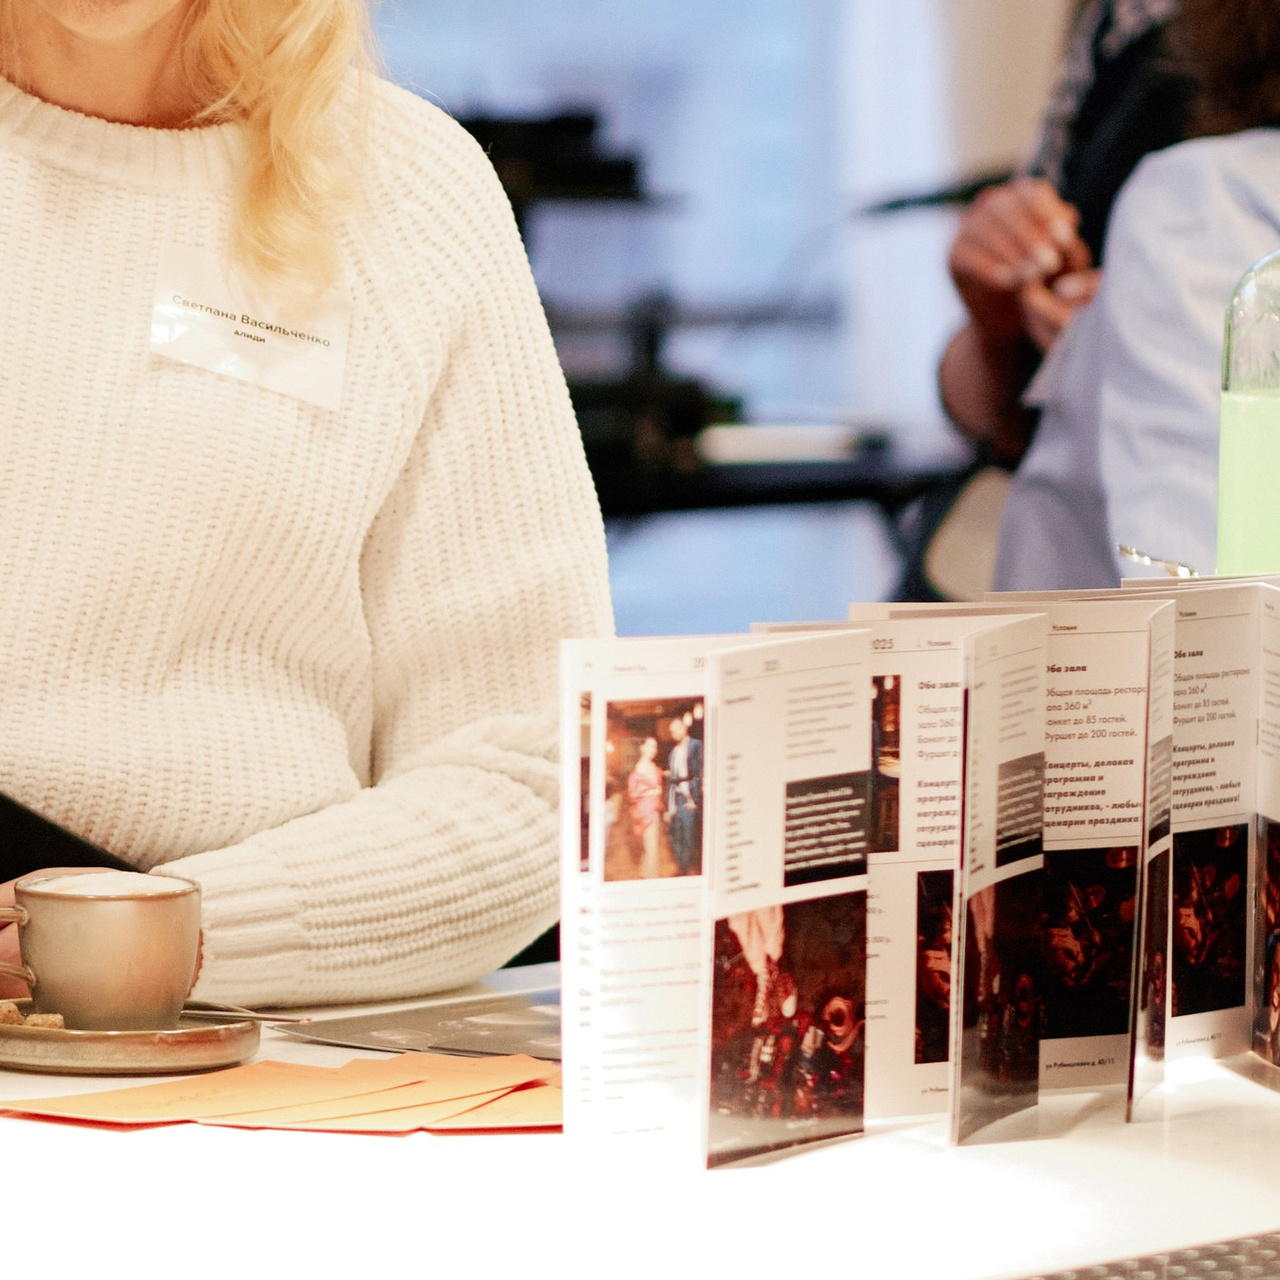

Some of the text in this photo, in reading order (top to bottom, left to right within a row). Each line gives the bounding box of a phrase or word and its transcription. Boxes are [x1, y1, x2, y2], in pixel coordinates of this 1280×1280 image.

[172, 295, 331, 348] Светлана Васильченко
[1064, 665, 1087, 673] зала
[1075, 688, 1111, 696] площадь
[1188, 686, 1199, 695] 360
[1064, 701, 1081, 711] 360
[1203, 699, 1210, 708] 85
[1073, 718, 1084, 726] до
[1086, 715, 1097, 724] 85
[1206, 712, 1217, 721] 200
[1078, 732, 1088, 740] до
[1091, 729, 1107, 739] 200
[1093, 759, 1134, 768] деловая
[1045, 804, 1103, 814] отрудников,
